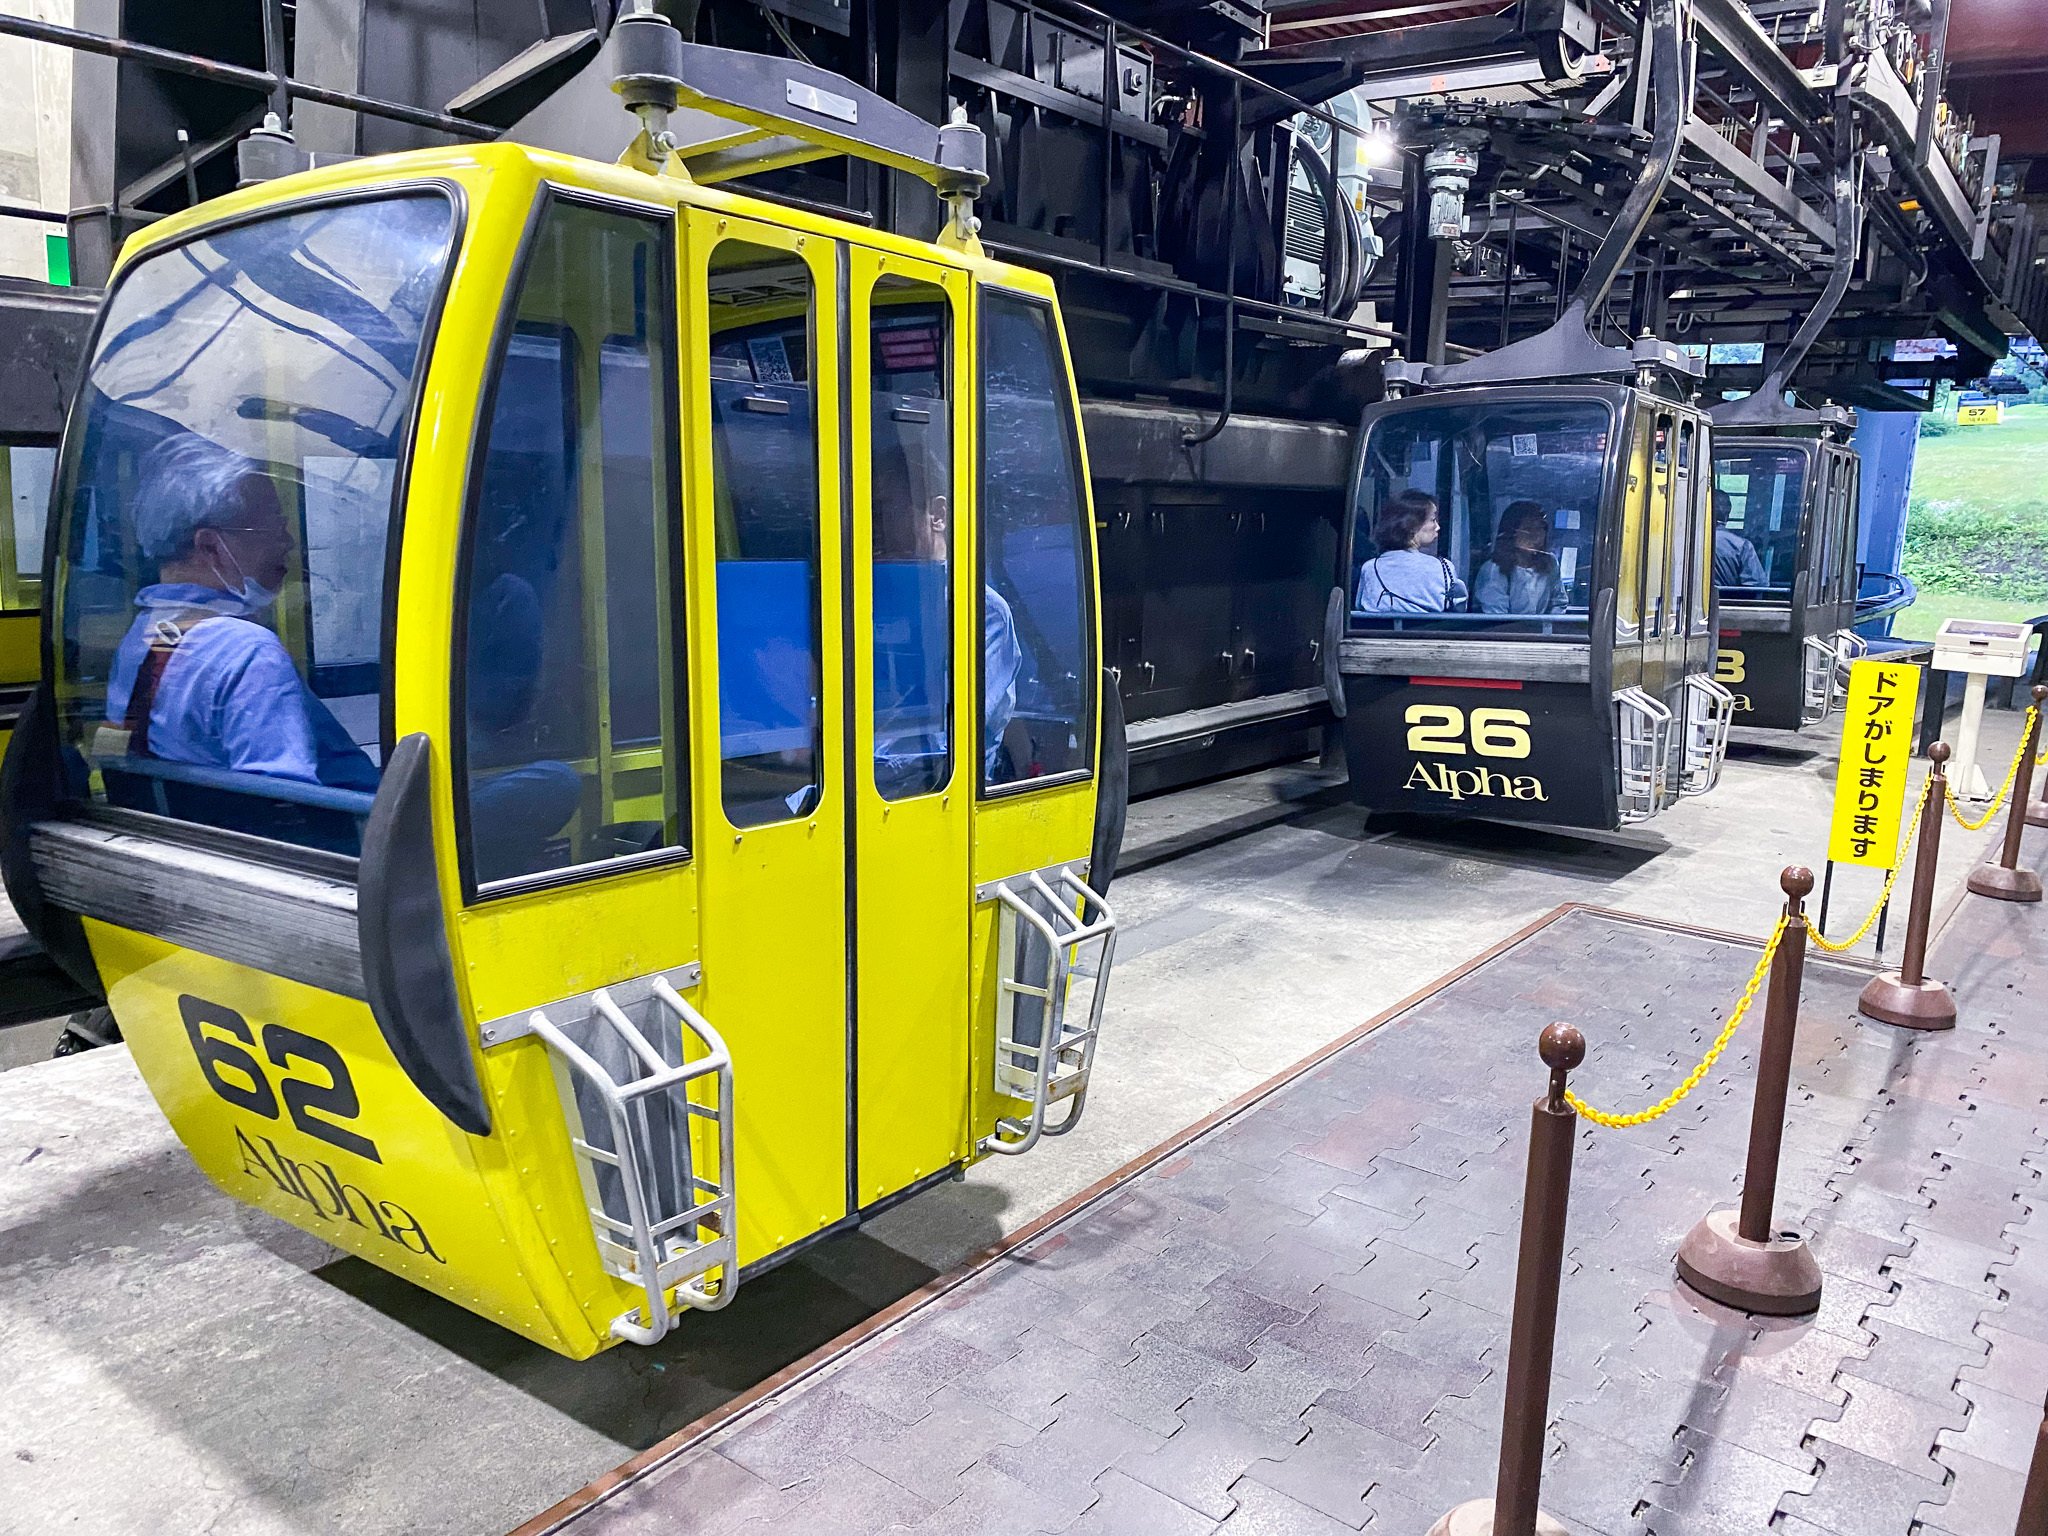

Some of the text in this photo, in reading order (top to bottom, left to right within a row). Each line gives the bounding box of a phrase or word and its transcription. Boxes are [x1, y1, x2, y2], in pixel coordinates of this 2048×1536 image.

[1968, 408, 1987, 416] 57
[1404, 704, 1531, 759] 26
[1850, 672, 1898, 858] ドアがしまります
[1402, 760, 1549, 802] Alpha
[177, 993, 383, 1165] 62
[235, 1125, 446, 1264] Alpha
